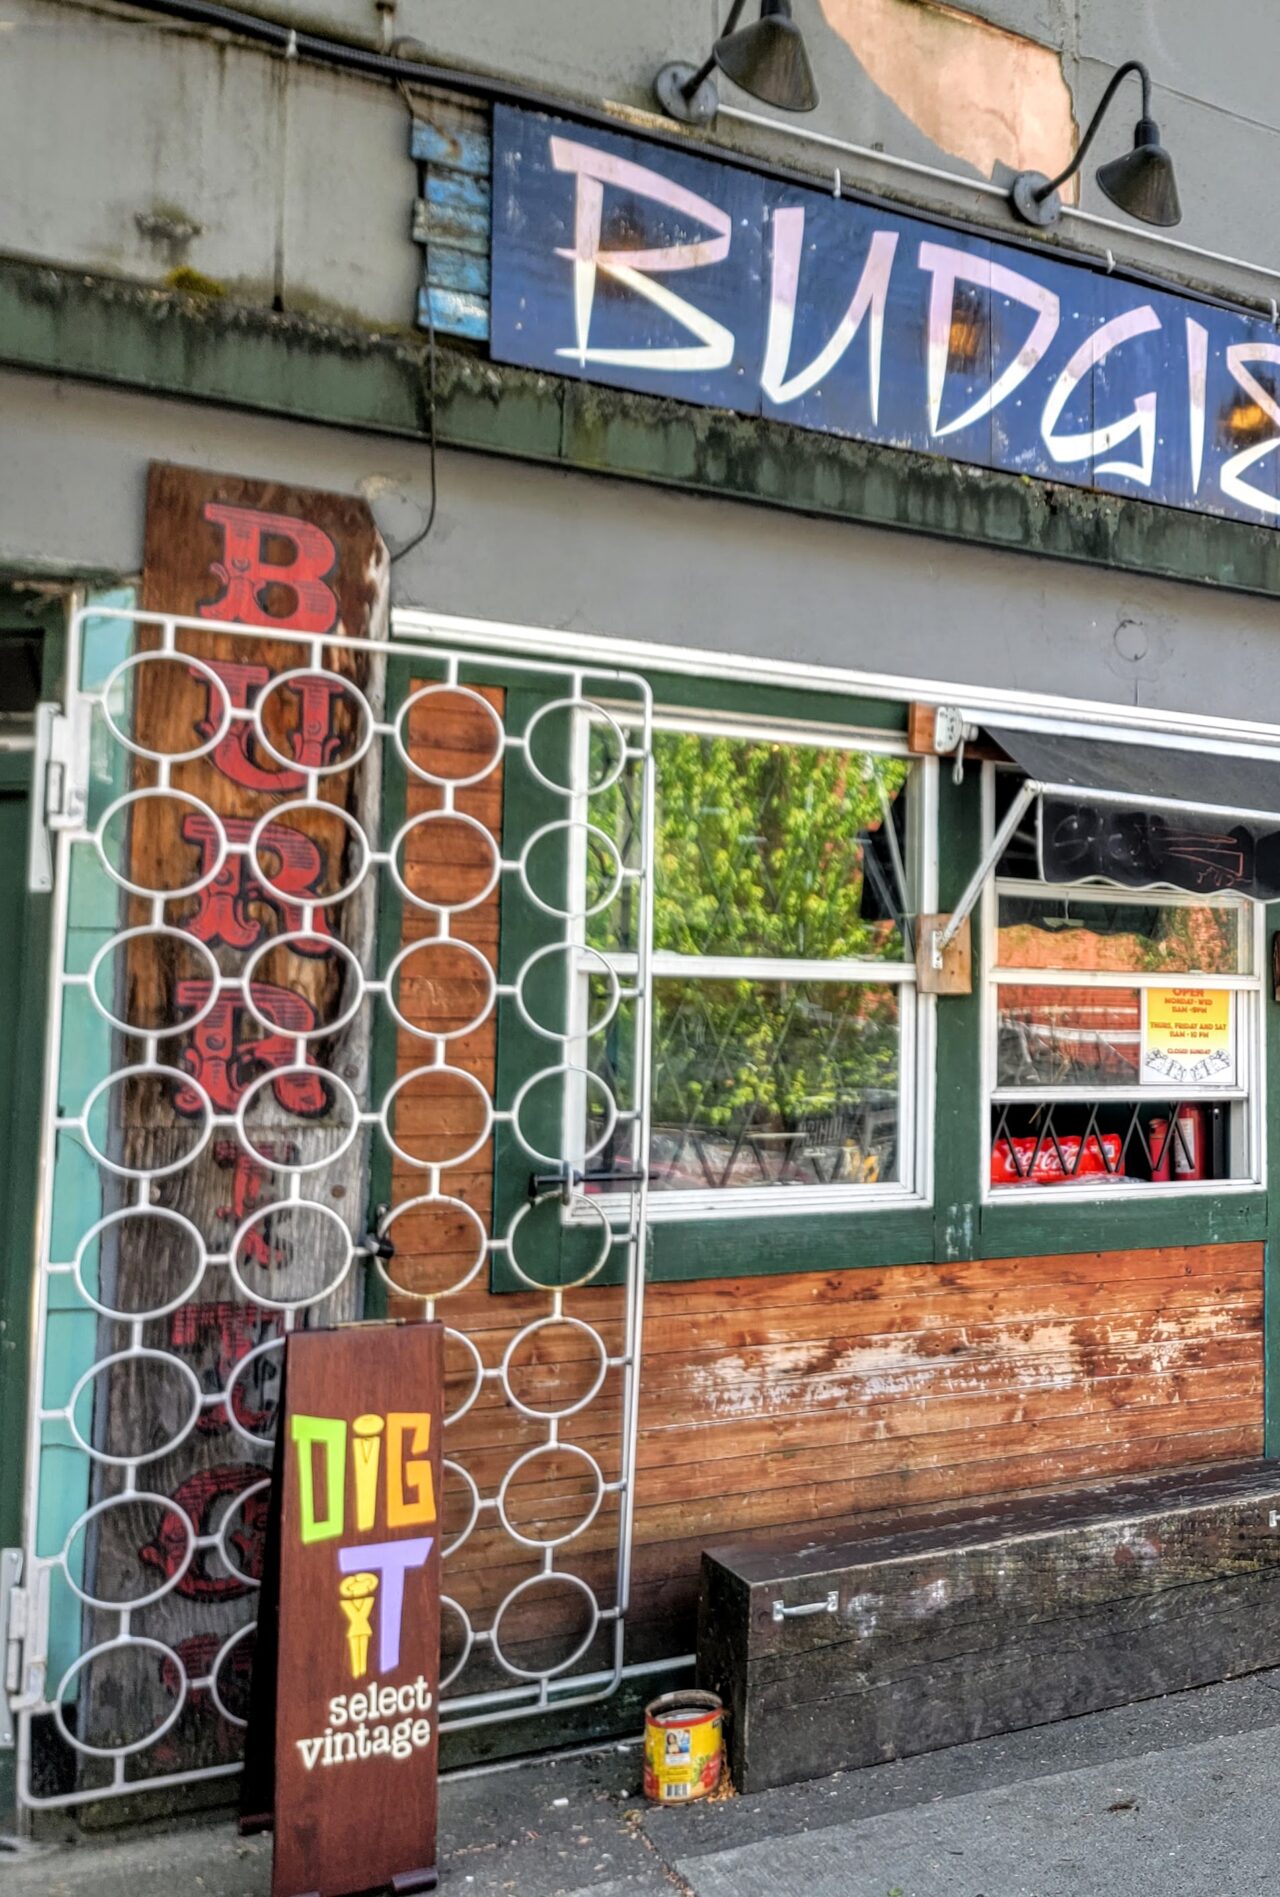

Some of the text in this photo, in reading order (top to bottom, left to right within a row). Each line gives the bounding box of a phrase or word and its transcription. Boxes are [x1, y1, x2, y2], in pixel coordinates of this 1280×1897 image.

[1172, 988, 1204, 997] OPEN
[329, 1675, 432, 1727] select
[297, 1716, 432, 1770] vintage
